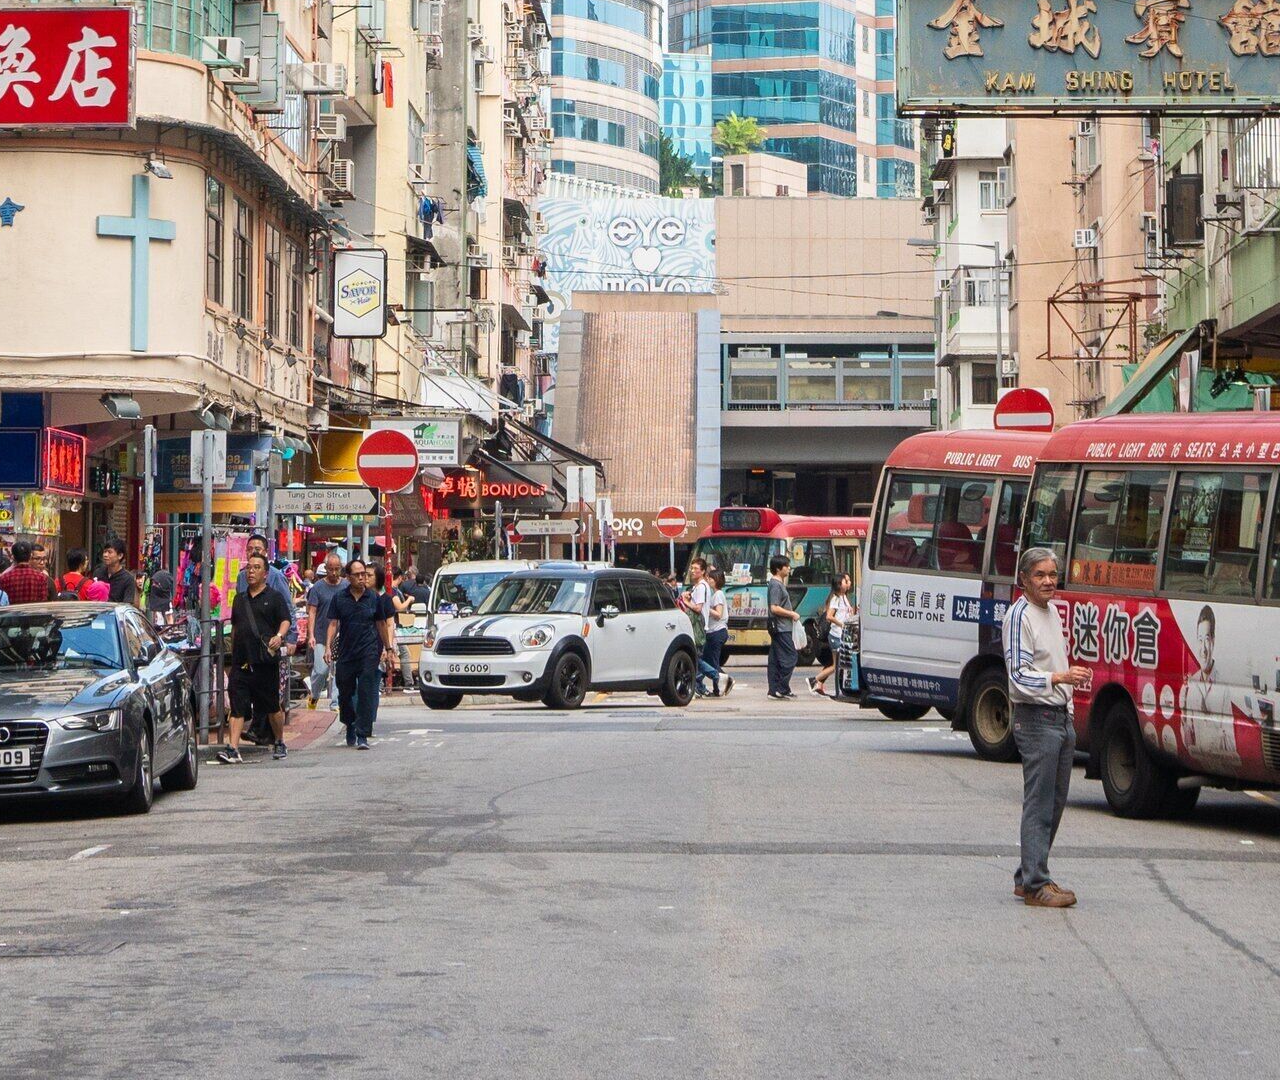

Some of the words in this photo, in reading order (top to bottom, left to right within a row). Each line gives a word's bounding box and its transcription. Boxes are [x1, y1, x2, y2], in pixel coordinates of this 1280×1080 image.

[985, 71, 1036, 92] KAM
[1066, 70, 1134, 91] SHING
[1163, 70, 1235, 91] HOTEL
[1086, 443, 1116, 459] PUBLIC
[1118, 443, 1144, 458] LIGHT
[1147, 443, 1166, 458] BUS
[1171, 442, 1181, 458] 16
[1186, 442, 1216, 458] SEATS
[944, 451, 975, 467] PUBLIC
[974, 452, 999, 468] LIGHT
[1012, 453, 1031, 469] BUS
[288, 491, 305, 499] Tung
[891, 588, 946, 610] 保信信貸
[890, 609, 923, 621] CREDIT
[926, 611, 945, 622] ONE
[449, 664, 460, 672] GG
[464, 664, 489, 673] 6009
